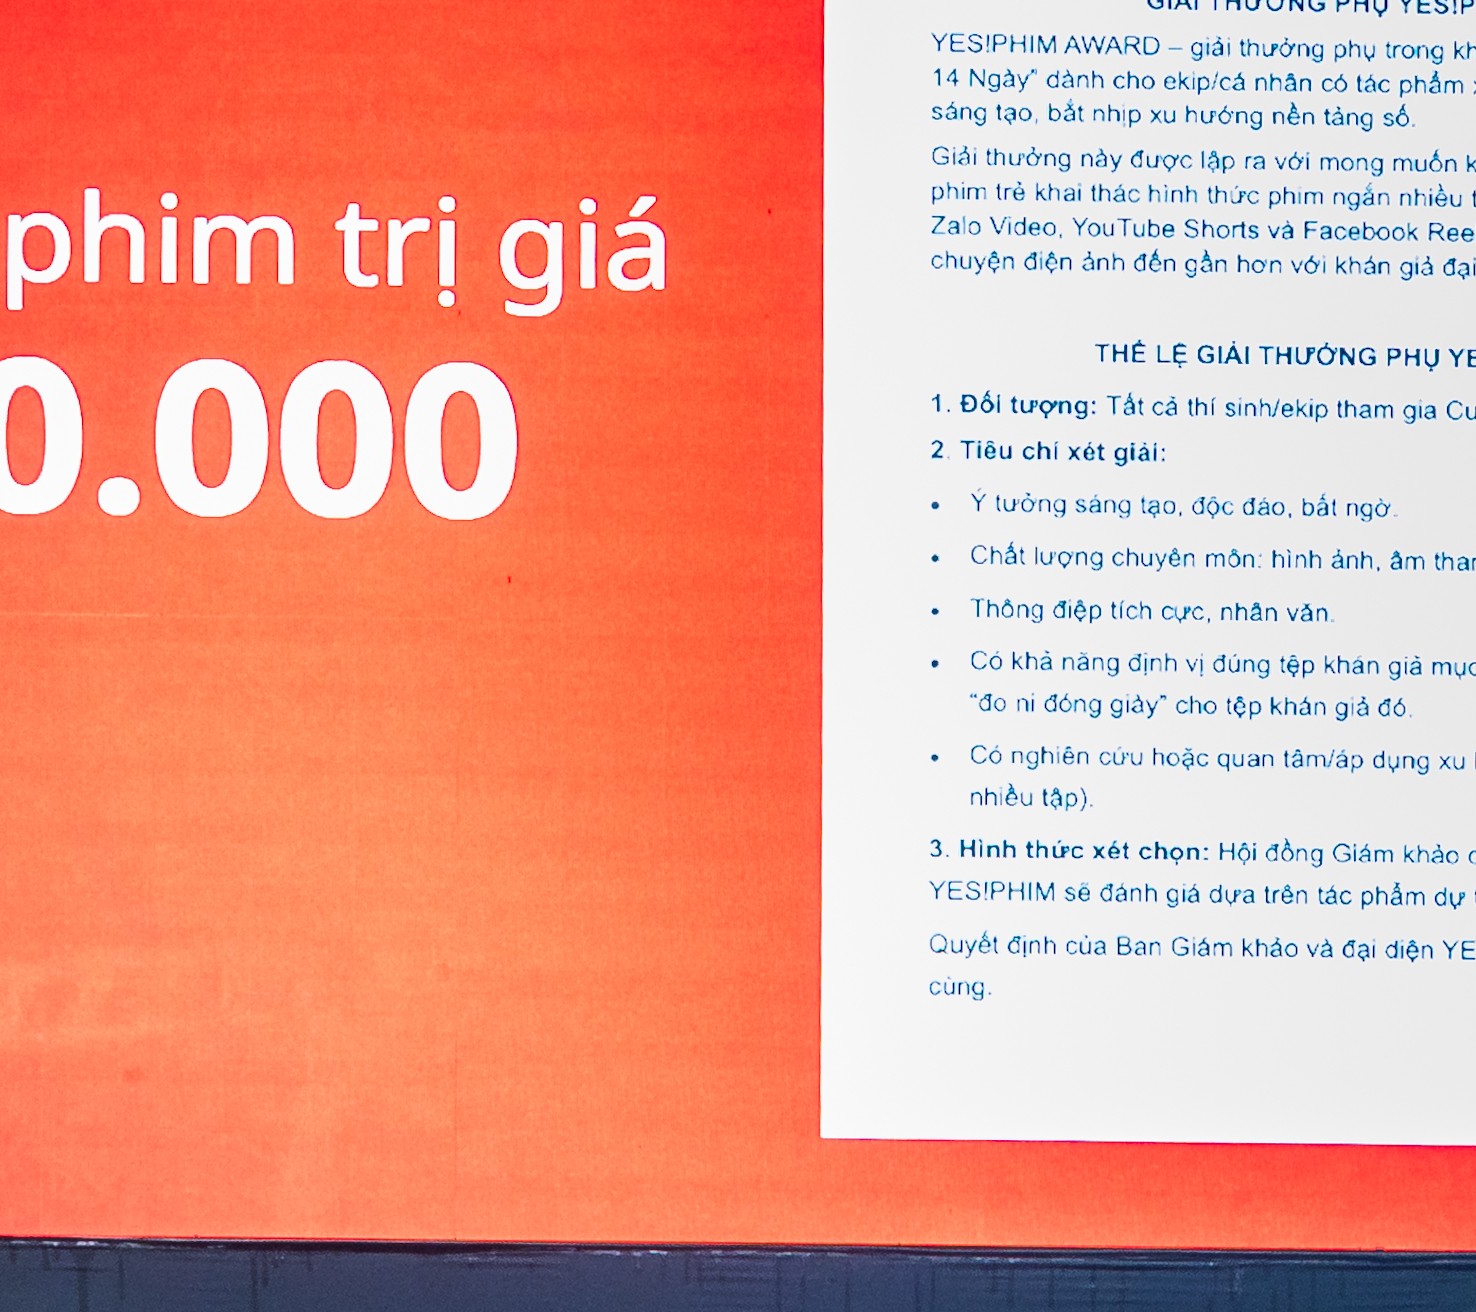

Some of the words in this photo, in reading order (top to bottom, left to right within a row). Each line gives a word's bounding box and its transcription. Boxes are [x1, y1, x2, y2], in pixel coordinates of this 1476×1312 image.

[931, 33, 1057, 54] YES!PHIM
[1064, 35, 1160, 56] AWARD
[1190, 36, 1231, 62] giải
[1239, 37, 1324, 63] thưởng
[1334, 40, 1376, 63] phụ
[1385, 41, 1444, 65] trong
[7, 188, 293, 310] phim
[335, 197, 455, 307] trị
[500, 196, 665, 316] giá
[931, 250, 1015, 275] chuyện
[1024, 251, 1072, 274] điện
[1082, 251, 1125, 272] ảnh
[1133, 248, 1176, 273] đến
[1184, 249, 1227, 279] gần
[1237, 254, 1282, 274] hơn
[1291, 255, 1326, 275] với
[1335, 255, 1390, 275] khán
[1400, 256, 1434, 281] giả
[1443, 257, 1476, 280] đại
[1095, 339, 1146, 363] THỂ
[1157, 342, 1187, 368] LỆ
[1197, 341, 1250, 365] GIẢI
[1259, 342, 1377, 366] THƯỞNG
[1387, 348, 1440, 372] PHỤ
[931, 439, 949, 459] 2.
[960, 440, 1012, 460] Tiêu
[1022, 441, 1058, 461] chí
[1068, 442, 1105, 461] xét
[1114, 442, 1165, 467] giải:
[970, 598, 1043, 624] Thông
[1053, 599, 1102, 624] điệp
[1111, 600, 1152, 620] tích
[1161, 605, 1211, 624] cực,
[1221, 602, 1278, 622] nhân
[1287, 603, 1333, 622] văn.
[930, 838, 949, 857] 3.
[960, 838, 1016, 858] Hình
[1025, 839, 1084, 859] thức
[1093, 840, 1129, 860] xét
[1138, 841, 1208, 866] chọn:
[1219, 842, 1257, 865] Hội
[1265, 838, 1324, 868] đồng
[1332, 843, 1394, 863] Giám
[1403, 844, 1459, 864] khảo
